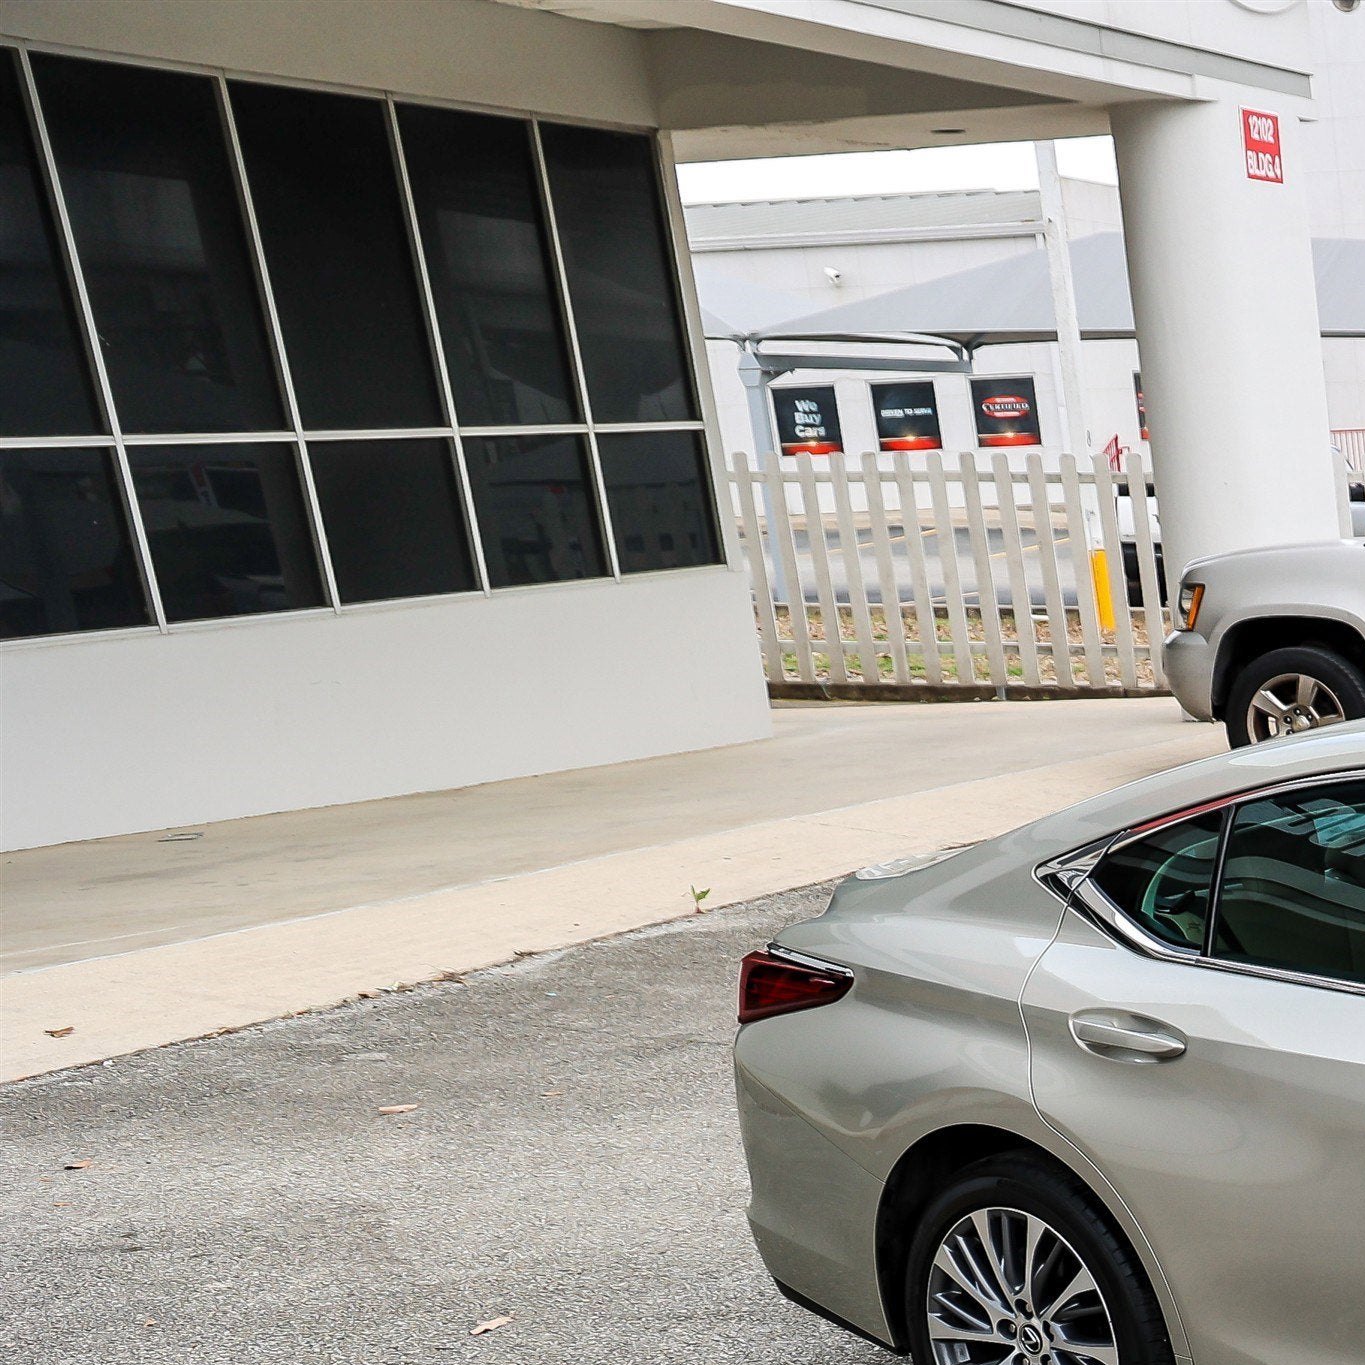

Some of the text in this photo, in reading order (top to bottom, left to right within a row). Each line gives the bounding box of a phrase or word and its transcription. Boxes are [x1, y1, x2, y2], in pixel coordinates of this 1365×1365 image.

[1248, 114, 1275, 144] 12102
[794, 400, 819, 413] We
[795, 424, 826, 438] Cars
